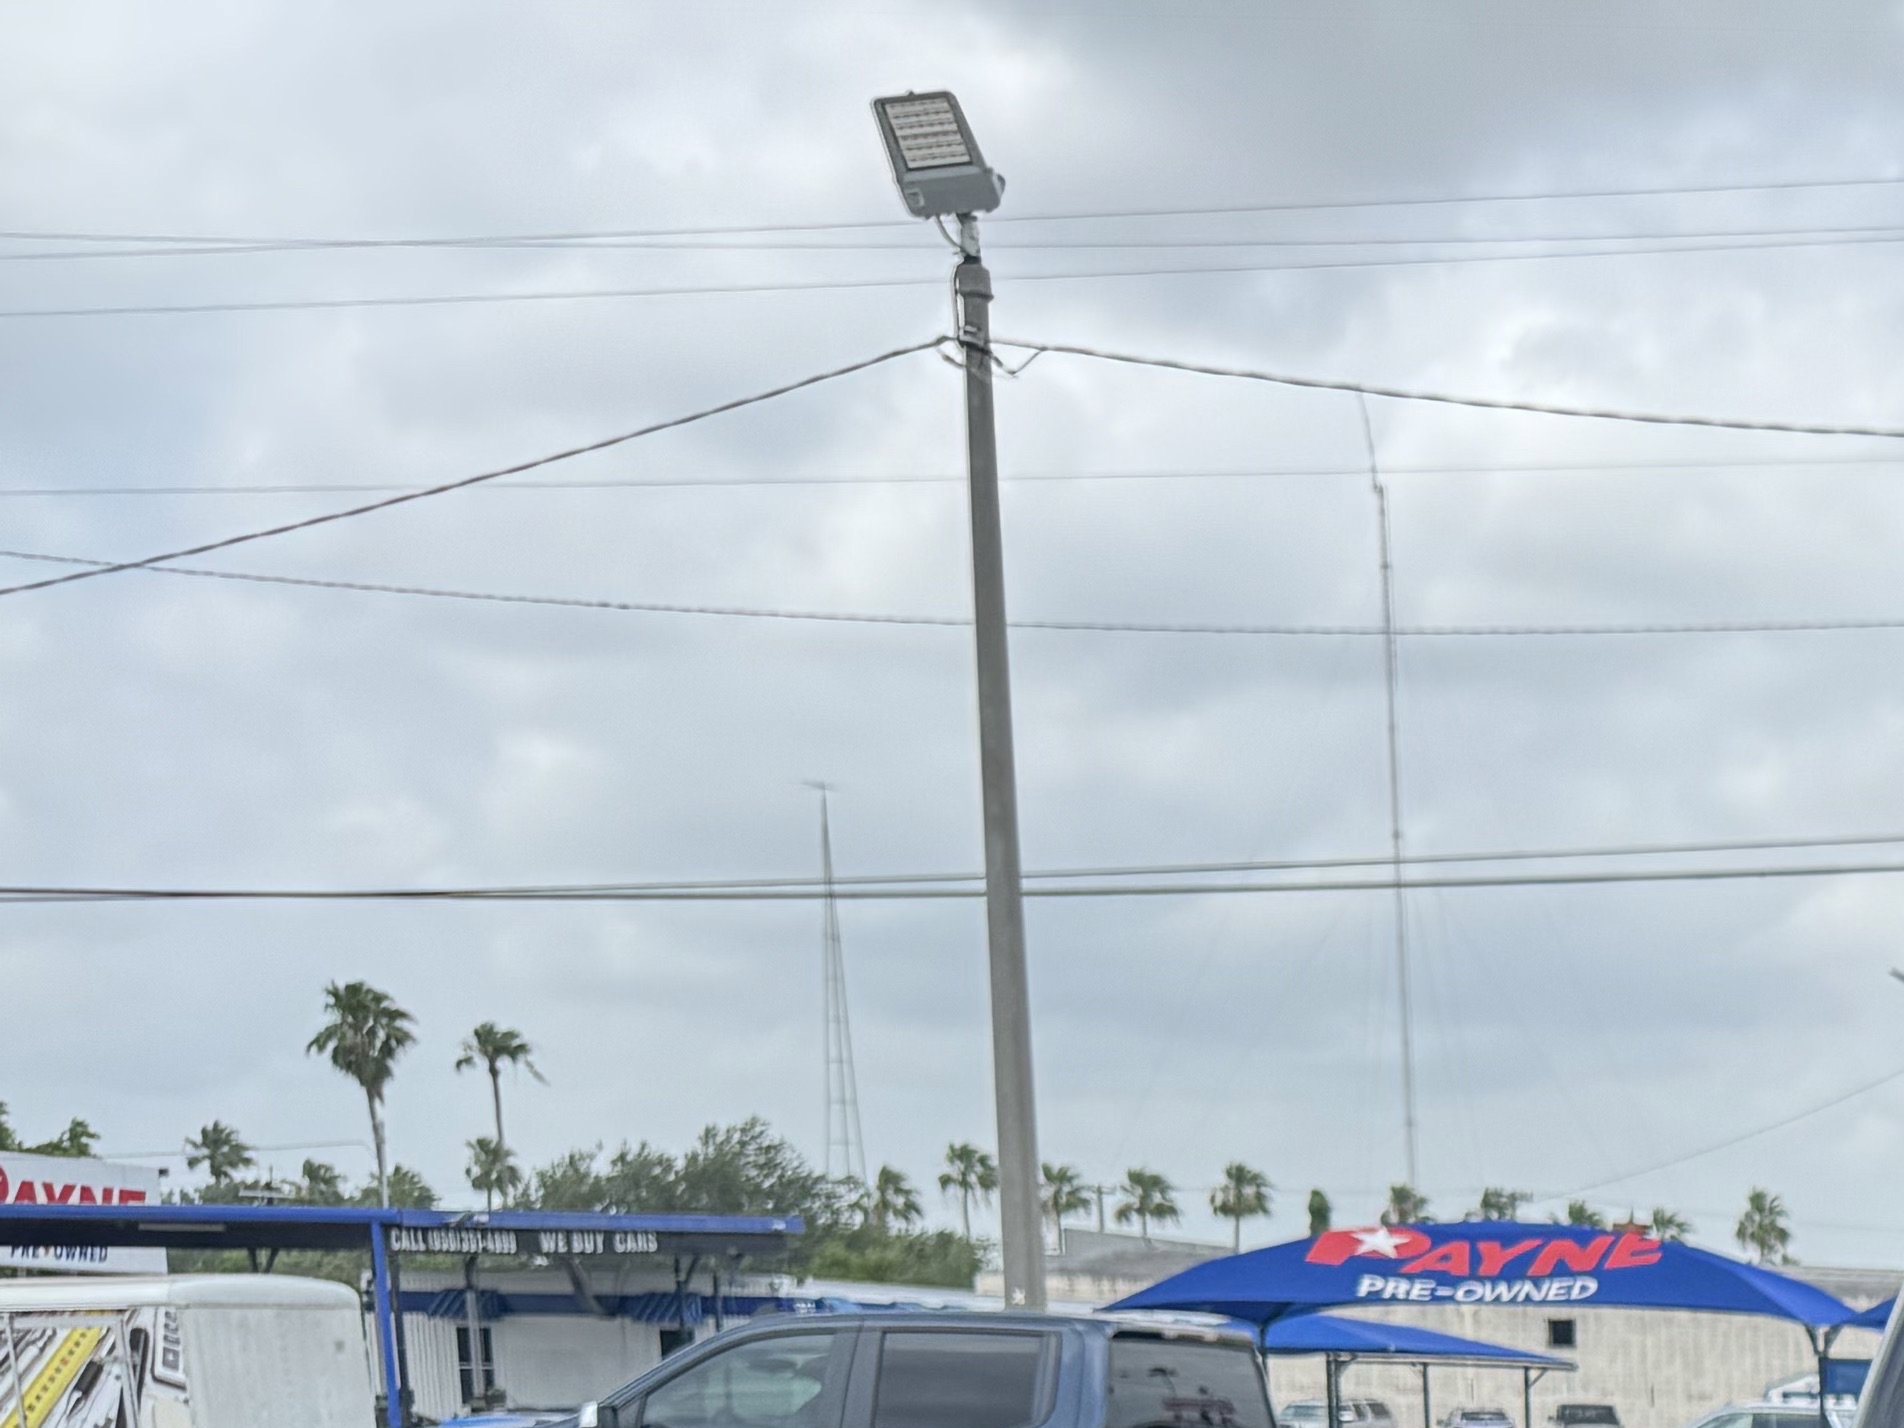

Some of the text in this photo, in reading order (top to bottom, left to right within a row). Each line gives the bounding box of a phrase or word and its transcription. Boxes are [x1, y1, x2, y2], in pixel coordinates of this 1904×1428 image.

[391, 1227, 426, 1251] CALL
[540, 1231, 568, 1253] WE
[571, 1231, 605, 1254] BUY
[614, 1231, 658, 1253] CARS
[1306, 1228, 1663, 1277] PAYNE
[1357, 1274, 1599, 1302] PRE-OWNED
